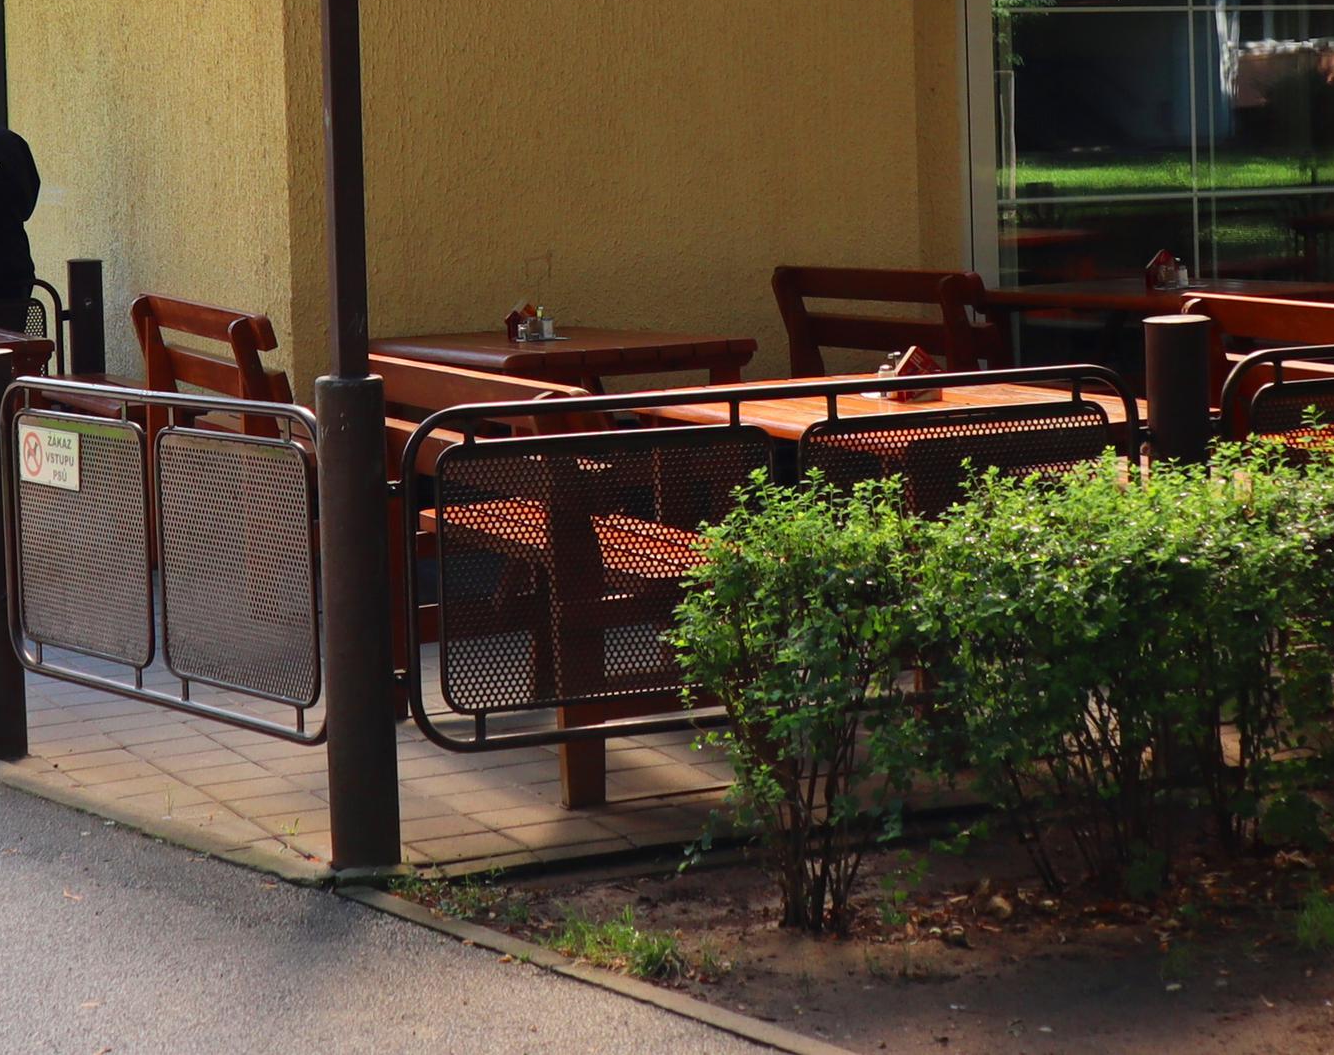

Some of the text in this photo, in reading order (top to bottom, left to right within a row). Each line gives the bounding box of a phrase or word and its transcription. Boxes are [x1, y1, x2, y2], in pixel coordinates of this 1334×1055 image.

[47, 433, 72, 450] ZÁKAZ
[45, 451, 75, 467] VSTUPU
[52, 468, 68, 482] PSŮ
